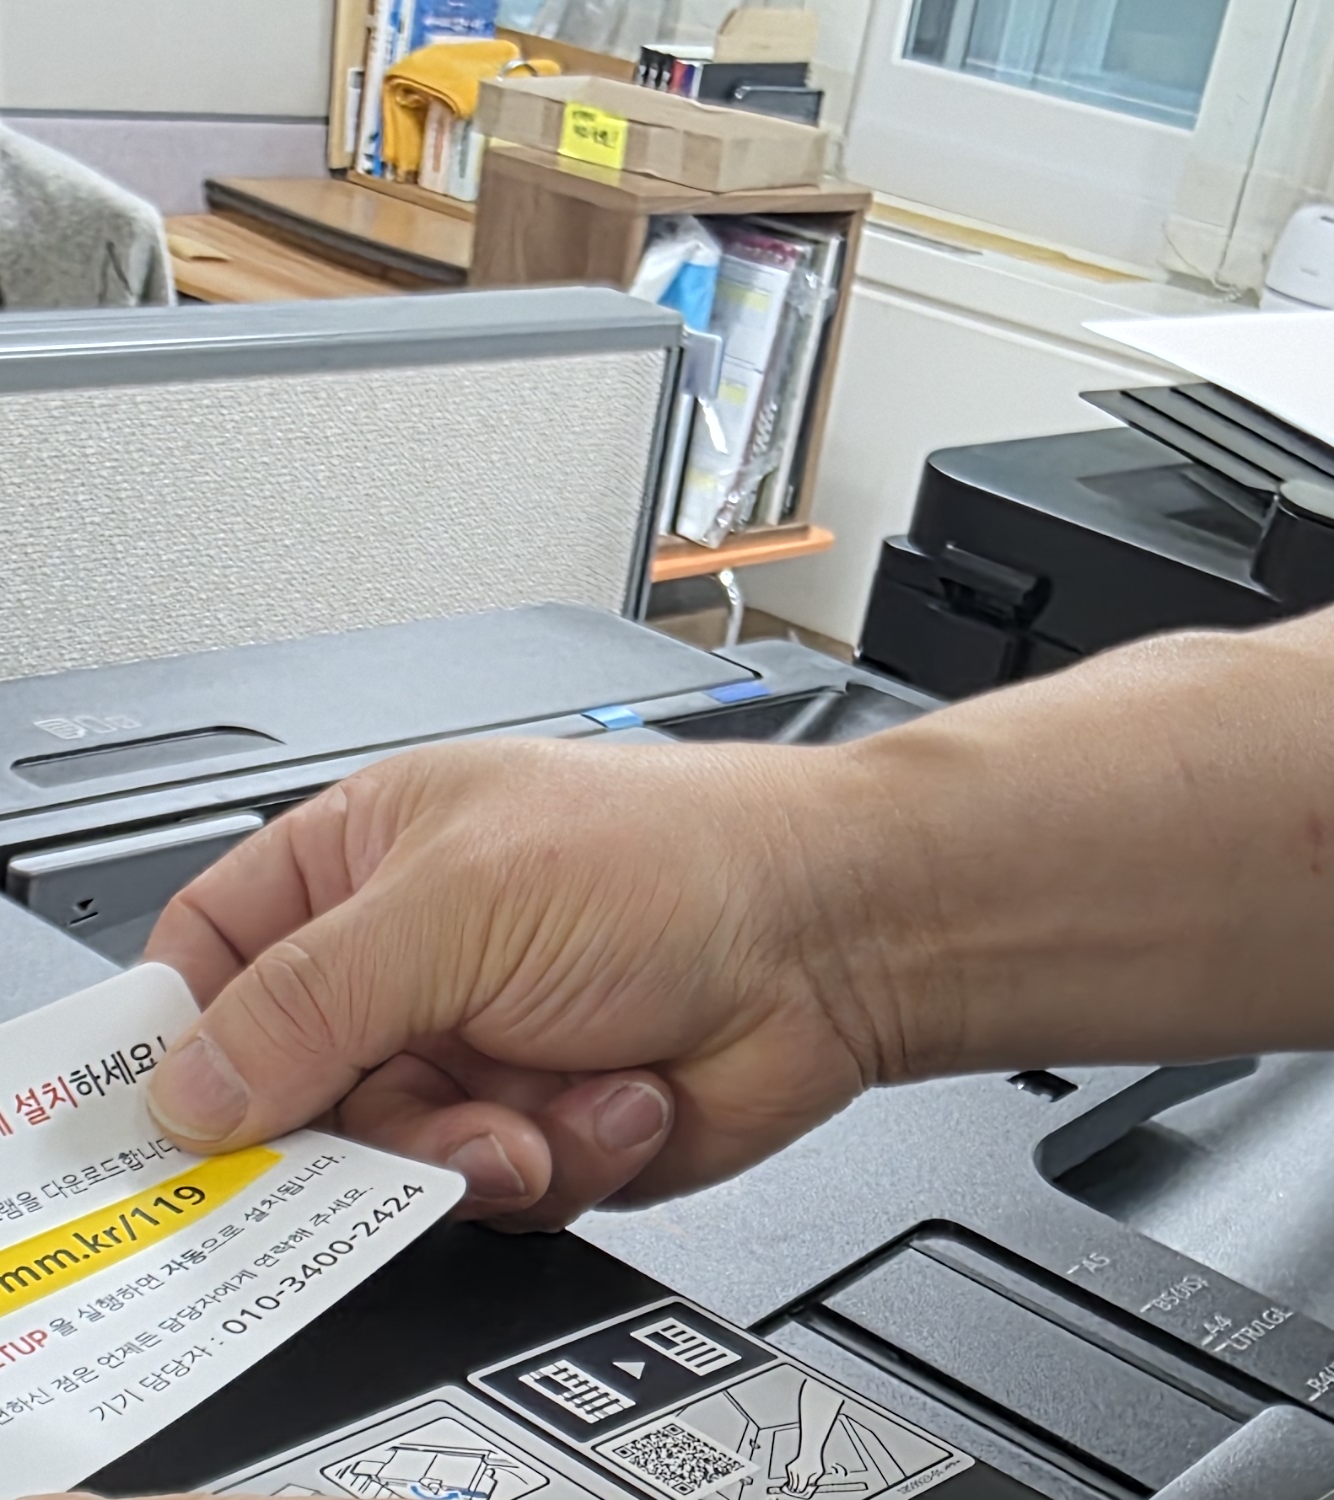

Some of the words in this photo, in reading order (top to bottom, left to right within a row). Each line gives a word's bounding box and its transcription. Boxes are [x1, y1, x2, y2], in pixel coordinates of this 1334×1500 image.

[50, 1366, 100, 1394] 점은
[97, 1331, 164, 1369] 언제든
[158, 1269, 258, 1334] 담당자에게
[253, 1226, 314, 1268] 연락해
[309, 1186, 374, 1227] 주세요.
[78, 1273, 165, 1323] 실행하면
[160, 1224, 245, 1277] 자동으로
[243, 1154, 346, 1224] 설치됩니다.
[89, 1387, 145, 1422] 기기
[138, 1344, 214, 1392] 담당자
[222, 1182, 425, 1335] 010-3400-2424
[1202, 1311, 1233, 1337] A4
